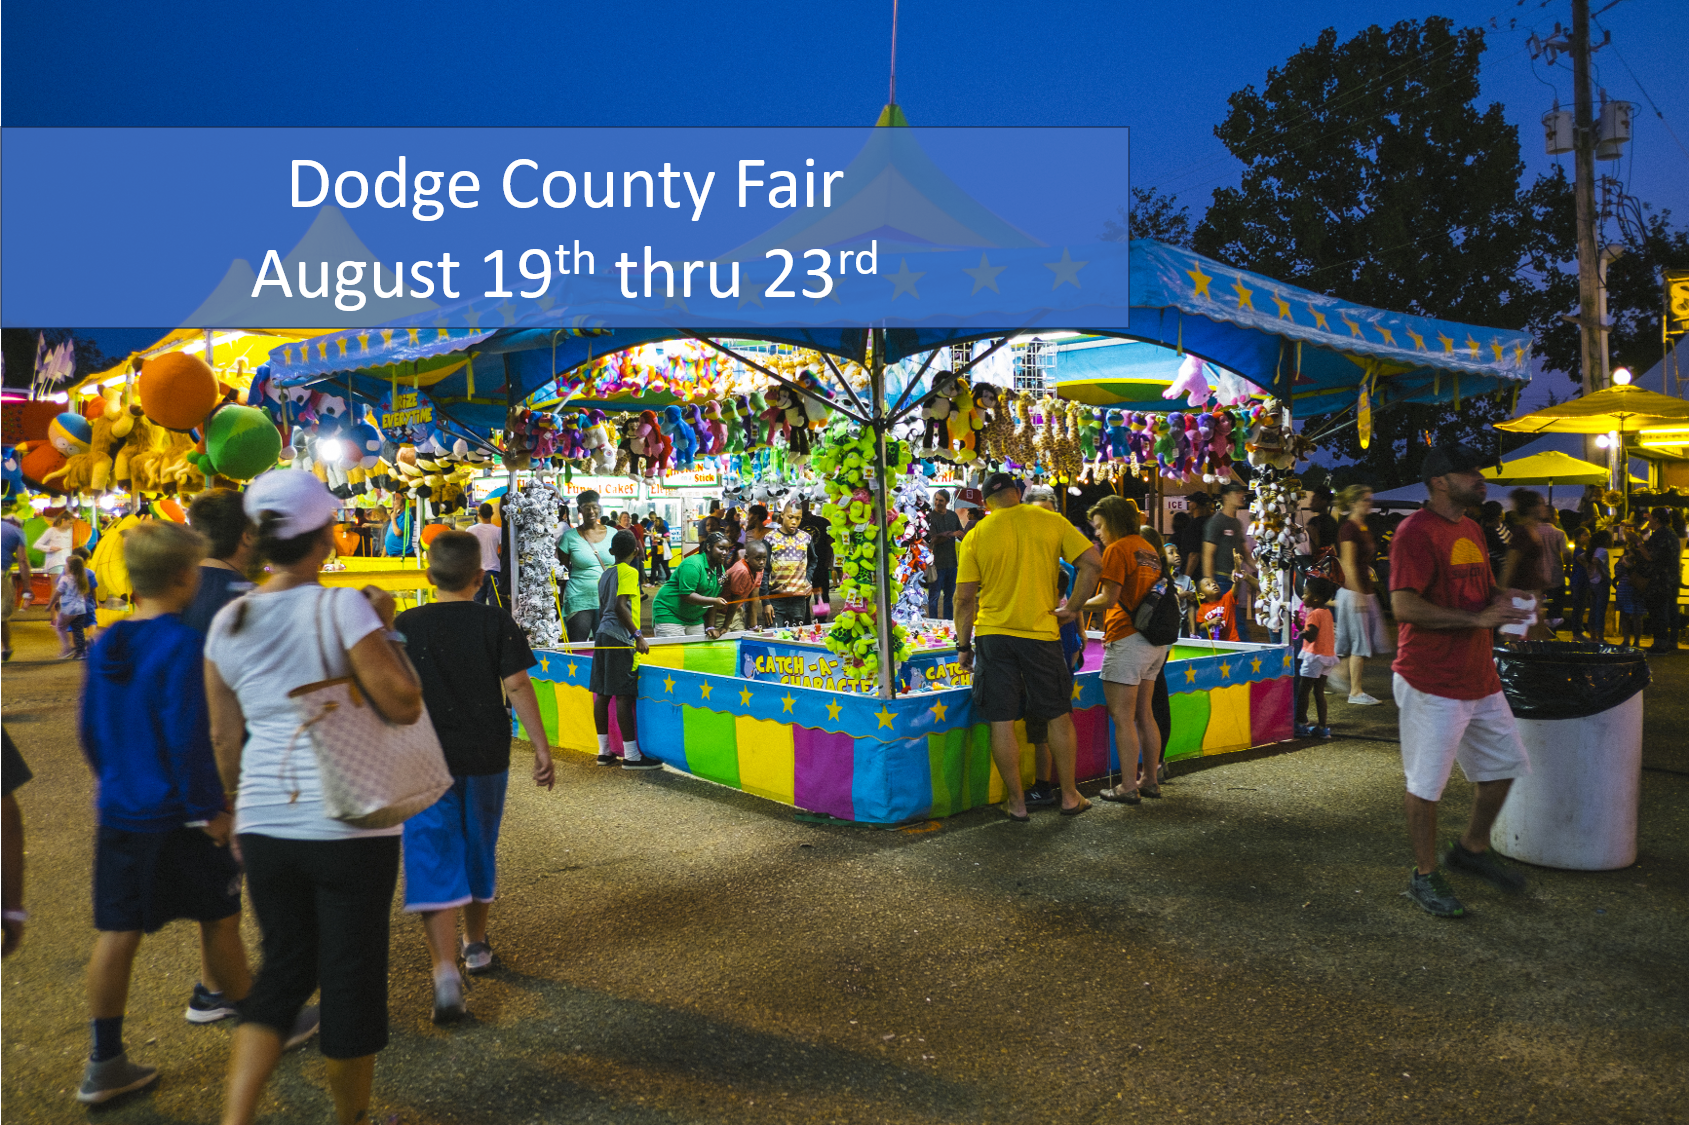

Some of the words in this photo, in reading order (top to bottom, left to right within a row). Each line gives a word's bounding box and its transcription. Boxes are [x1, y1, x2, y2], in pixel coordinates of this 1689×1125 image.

[382, 407, 433, 429] EVERYTIME
[694, 473, 715, 482] Stick
[605, 483, 634, 494] Cakes
[1168, 501, 1183, 509] ICE
[755, 655, 804, 675] CATCH
[925, 661, 969, 680] CATC
[780, 675, 878, 693] CHARACTE
